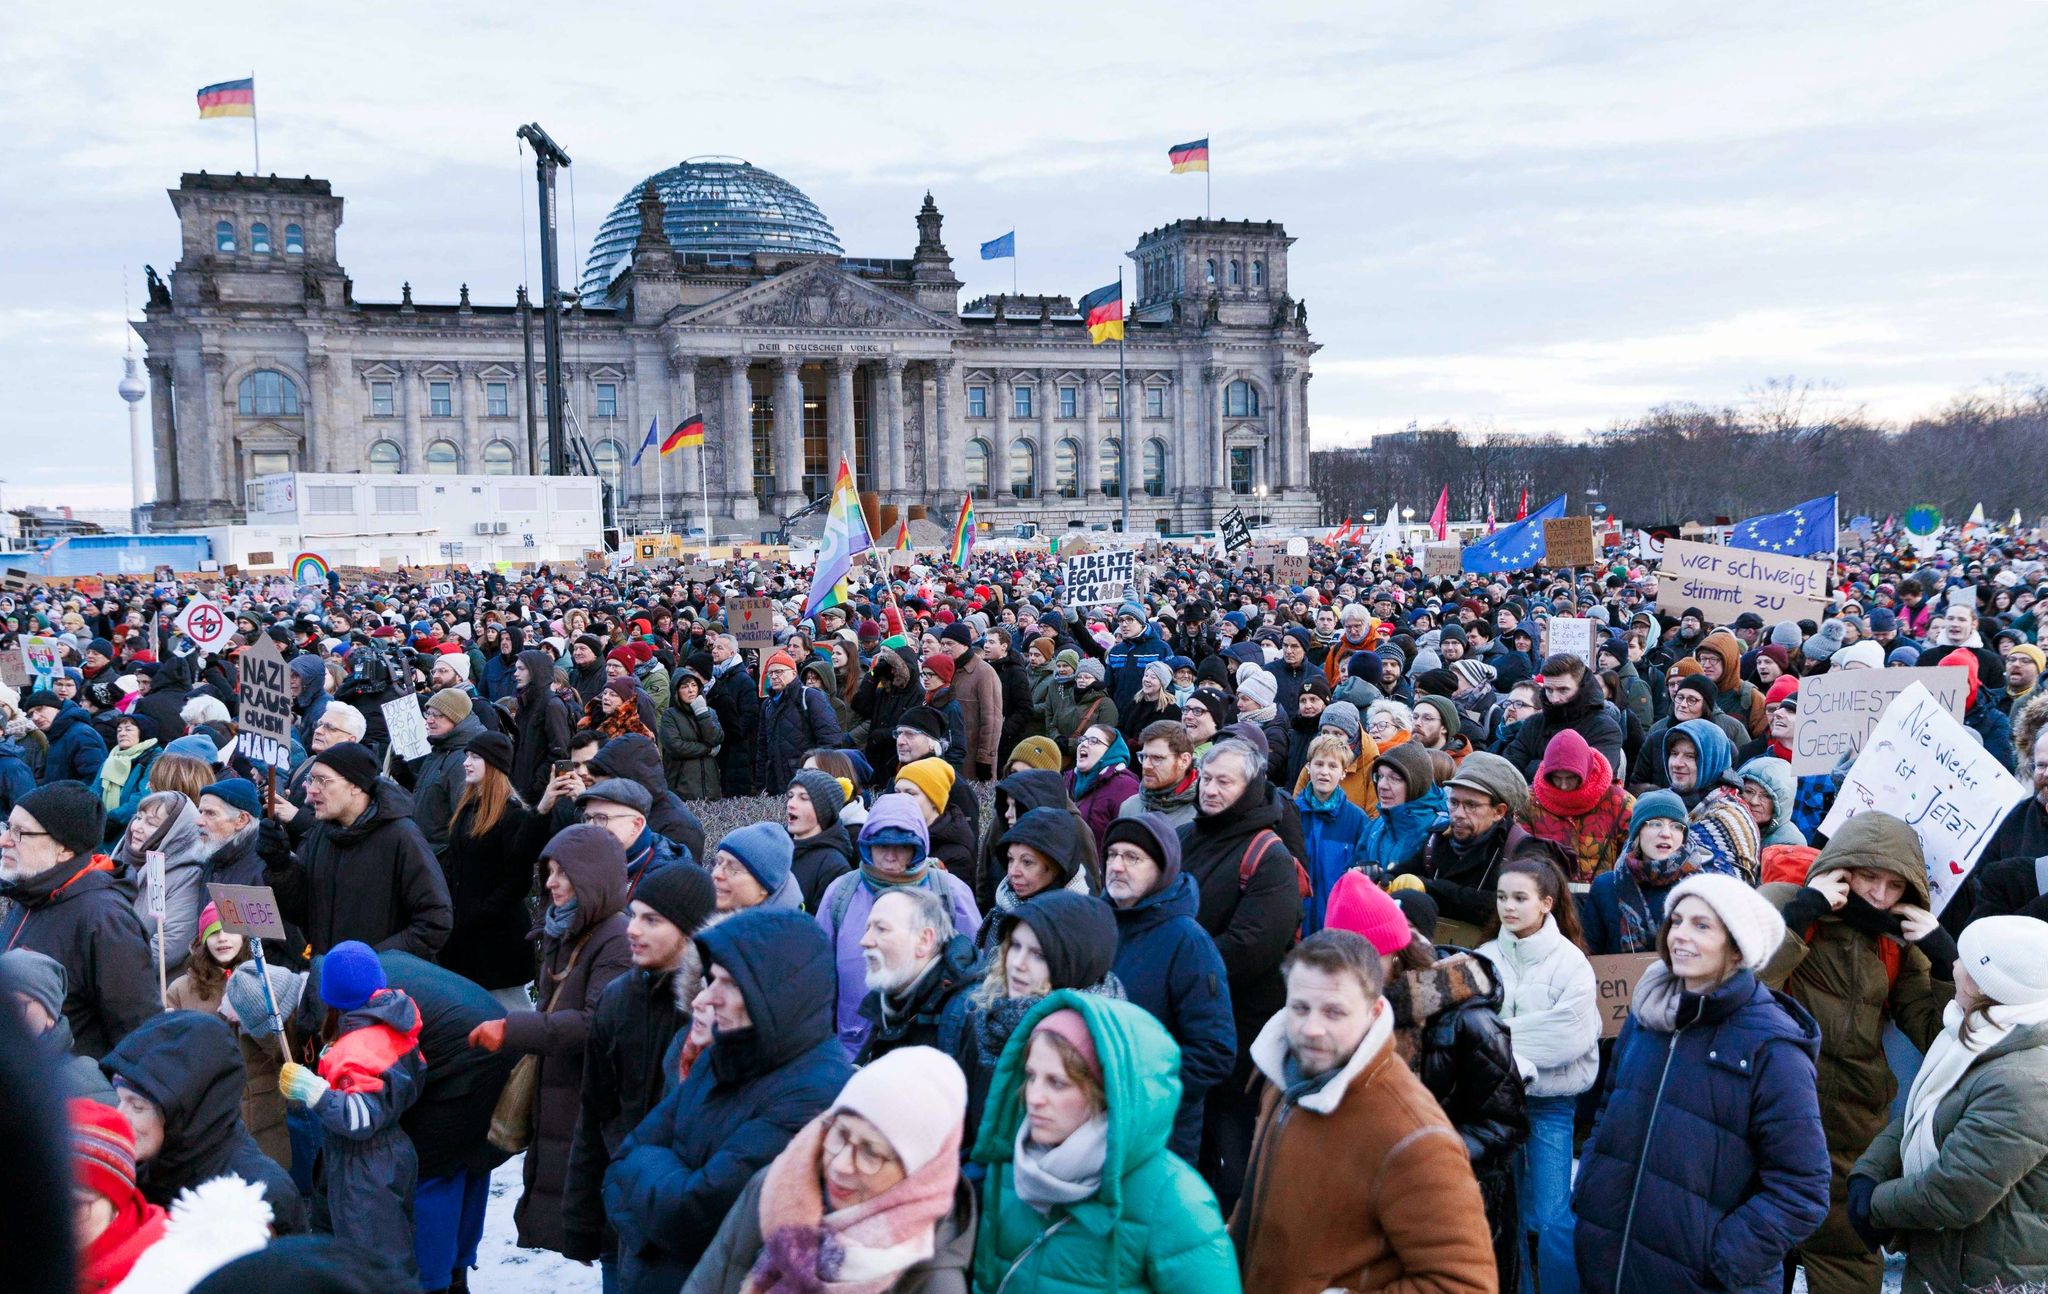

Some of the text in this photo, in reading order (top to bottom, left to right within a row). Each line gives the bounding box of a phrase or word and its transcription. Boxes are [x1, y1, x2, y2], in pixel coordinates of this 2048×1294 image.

[759, 343, 878, 352] DEM DEUTSCHEN VOLKE
[1681, 554, 1817, 595] wer schweigt
[433, 583, 451, 595] NO
[1682, 578, 1743, 605] stimmt
[243, 655, 285, 694] NAZI
[240, 683, 291, 718] RAUS
[1803, 677, 1956, 717] SCHWESTN
[1797, 719, 1862, 758] GEGEN
[1895, 758, 1917, 781] ist
[241, 901, 275, 925] LIEBE
[1595, 978, 1628, 999] en
